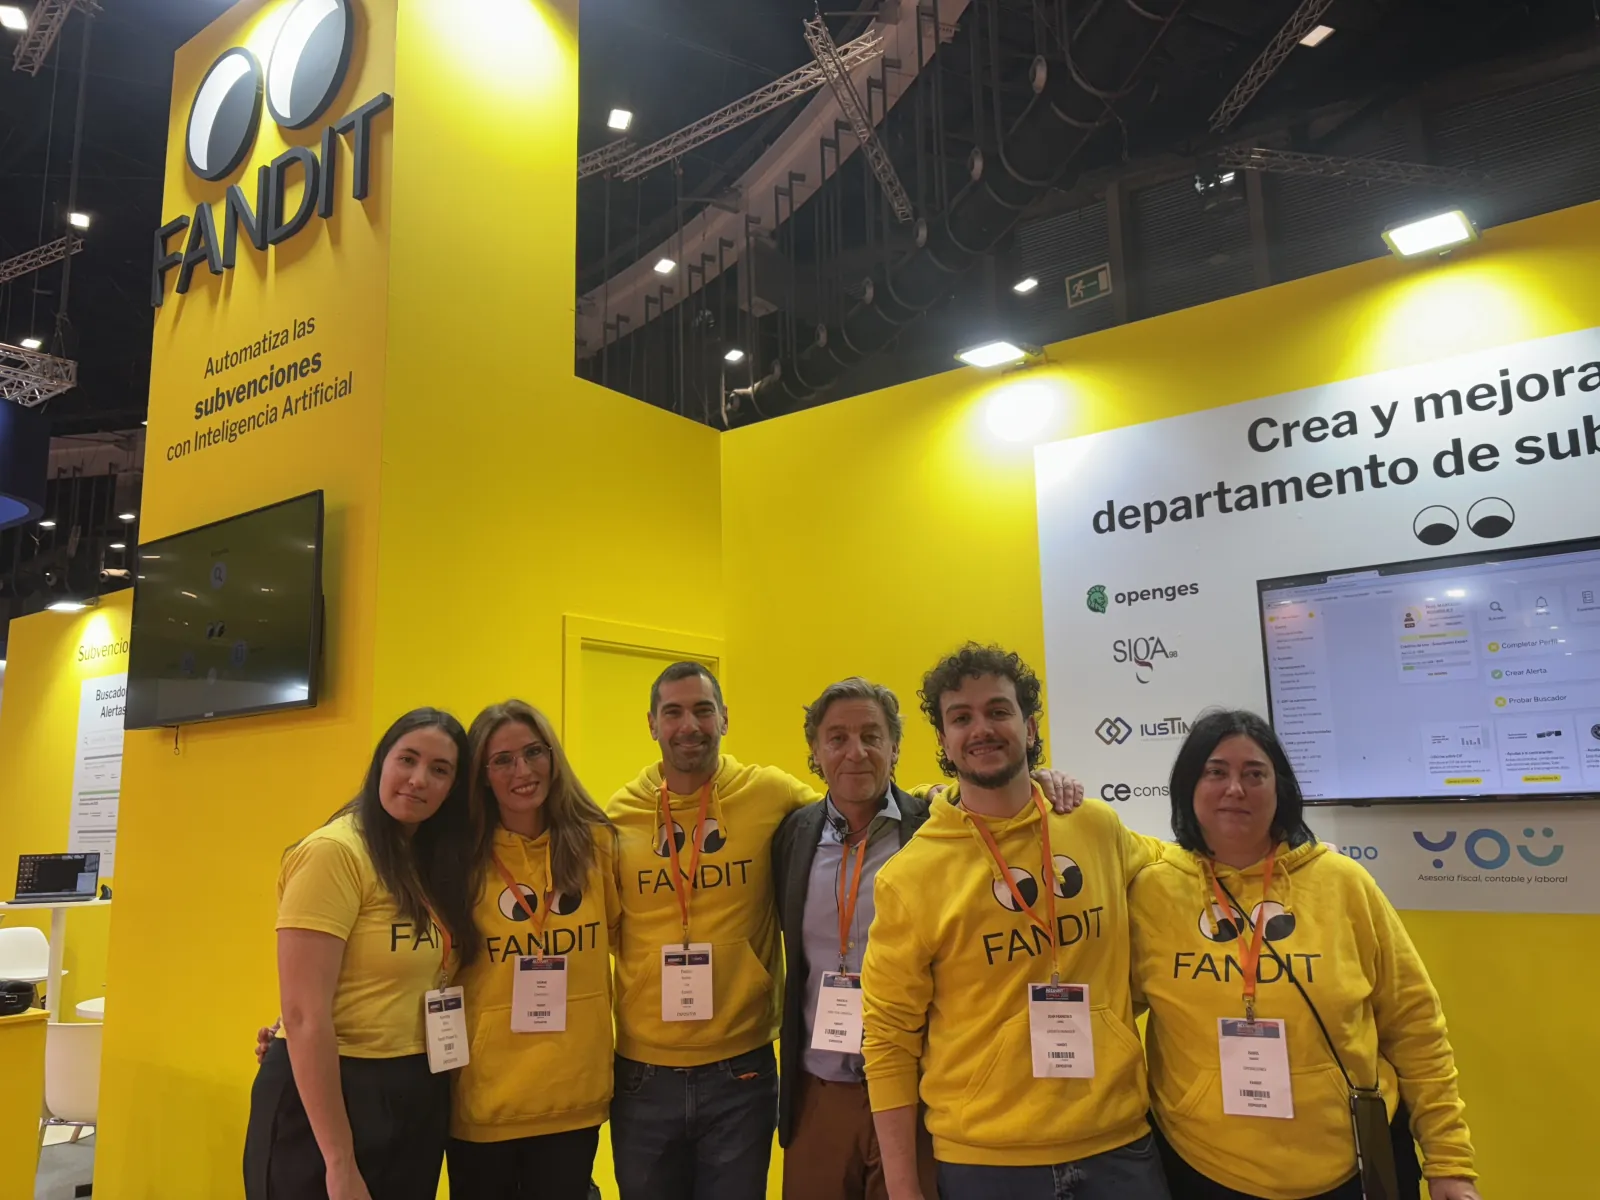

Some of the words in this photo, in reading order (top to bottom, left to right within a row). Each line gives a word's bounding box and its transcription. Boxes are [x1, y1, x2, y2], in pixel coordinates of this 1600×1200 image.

[150, 92, 392, 308] FANDIT
[203, 327, 289, 380] Automatiza
[293, 316, 316, 341] las
[194, 352, 322, 420] subvenciones
[166, 438, 191, 462] con
[194, 404, 278, 443] Inteligencia
[281, 371, 353, 420] Artificial
[1247, 409, 1359, 453] Crea
[1371, 399, 1400, 439] y
[1413, 360, 1600, 424] mejora
[1091, 453, 1420, 535] departamento
[1431, 437, 1500, 479] de
[1114, 582, 1200, 606] openges
[1501, 639, 1537, 649] Completar
[1539, 638, 1558, 646] Perfil
[1505, 669, 1524, 677] Crear
[1525, 667, 1548, 675] Alerta
[95, 685, 128, 701] Buscado
[1533, 695, 1568, 703] Buscador
[100, 705, 127, 719] Alertas
[1484, 875, 1525, 883] contable
[1526, 876, 1533, 884] y
[1534, 875, 1568, 883] laboral
[486, 921, 601, 963] FANDIT
